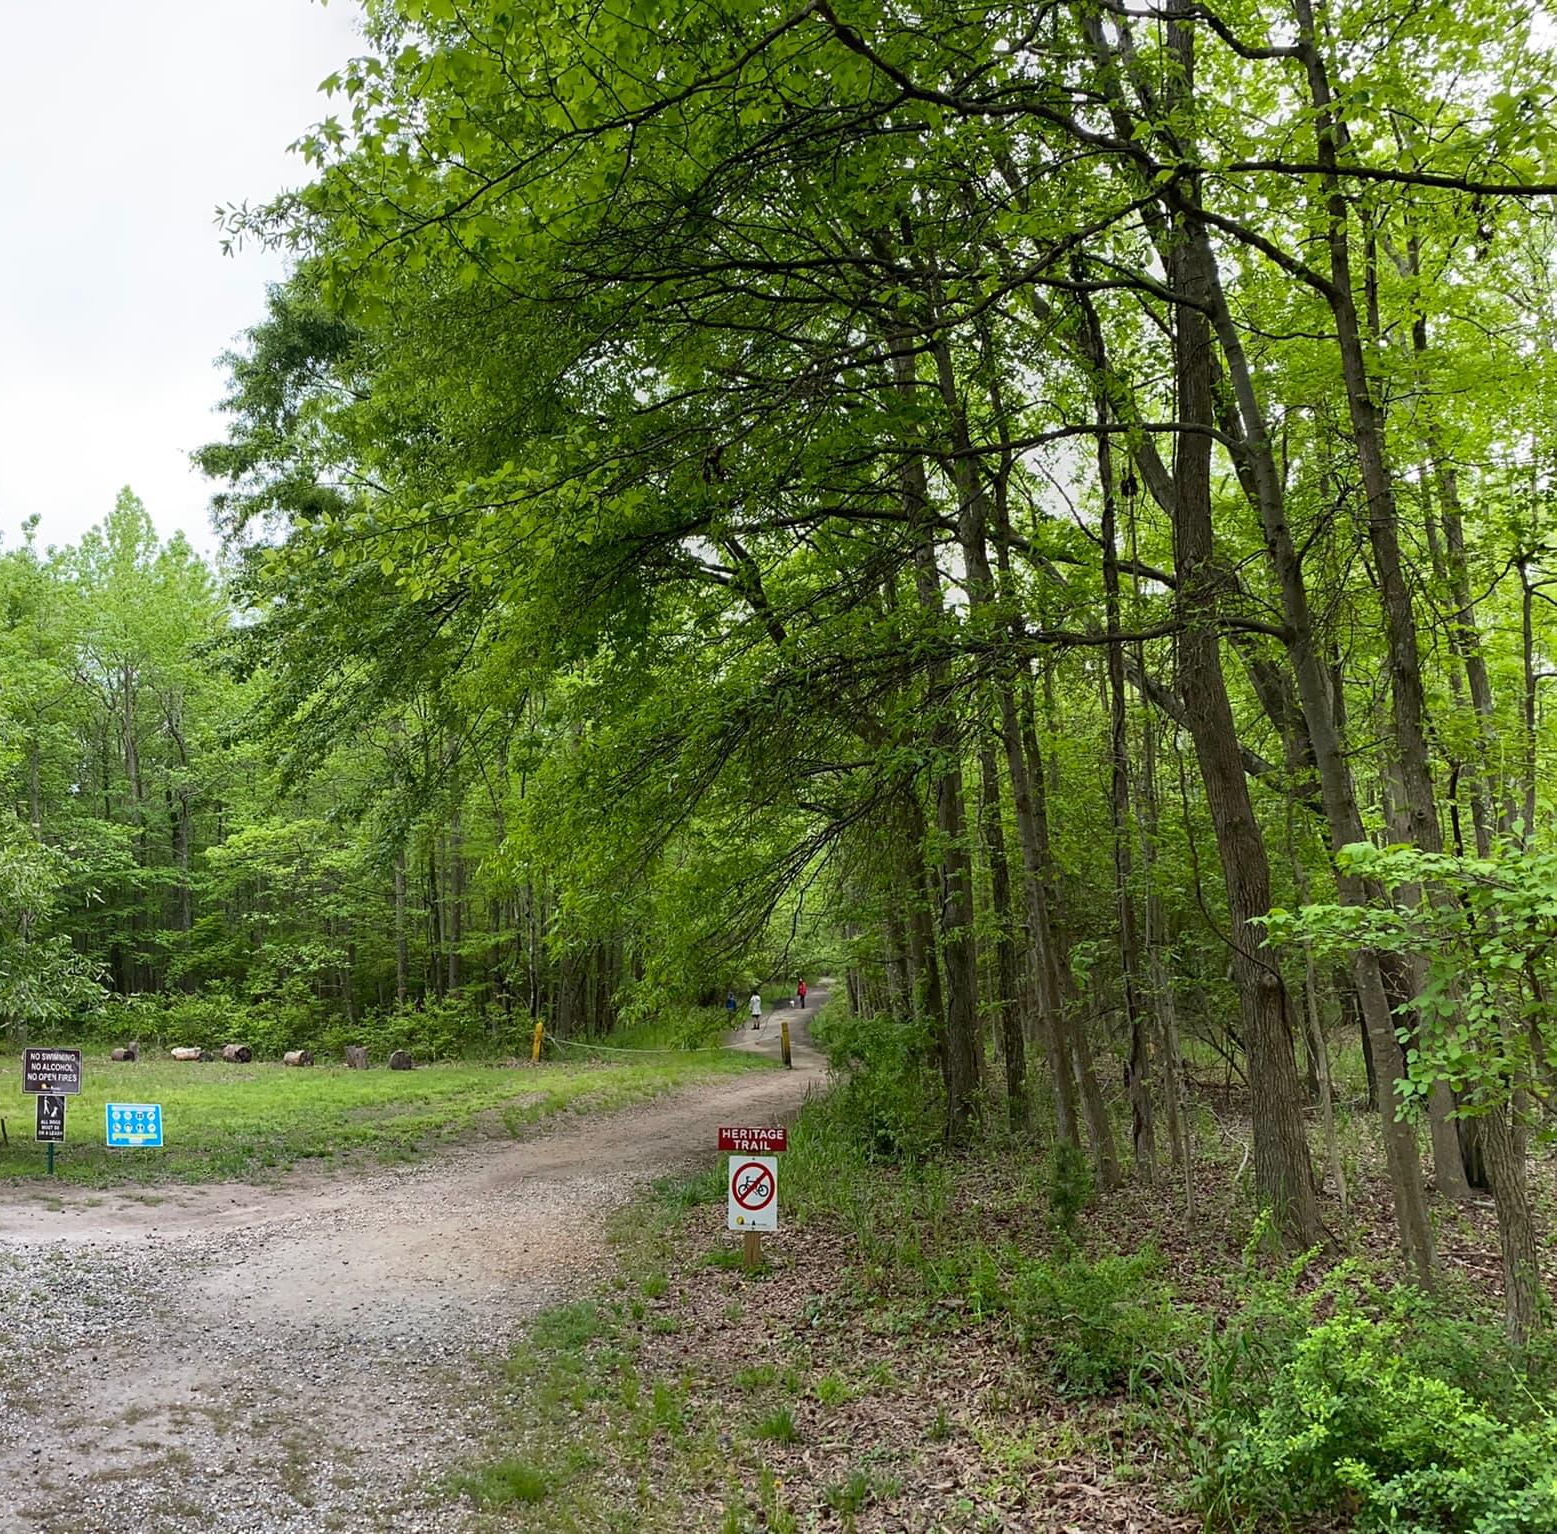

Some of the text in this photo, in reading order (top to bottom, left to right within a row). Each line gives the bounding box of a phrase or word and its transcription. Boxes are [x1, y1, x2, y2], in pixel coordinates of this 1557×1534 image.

[42, 1053, 76, 1061] SWIMMING
[42, 1063, 74, 1071] ALCOHOL
[38, 1073, 57, 1081] OPEN
[58, 1074, 77, 1082] FIRES
[722, 1129, 784, 1140] HERITAGE
[733, 1140, 771, 1150] TRAIL
